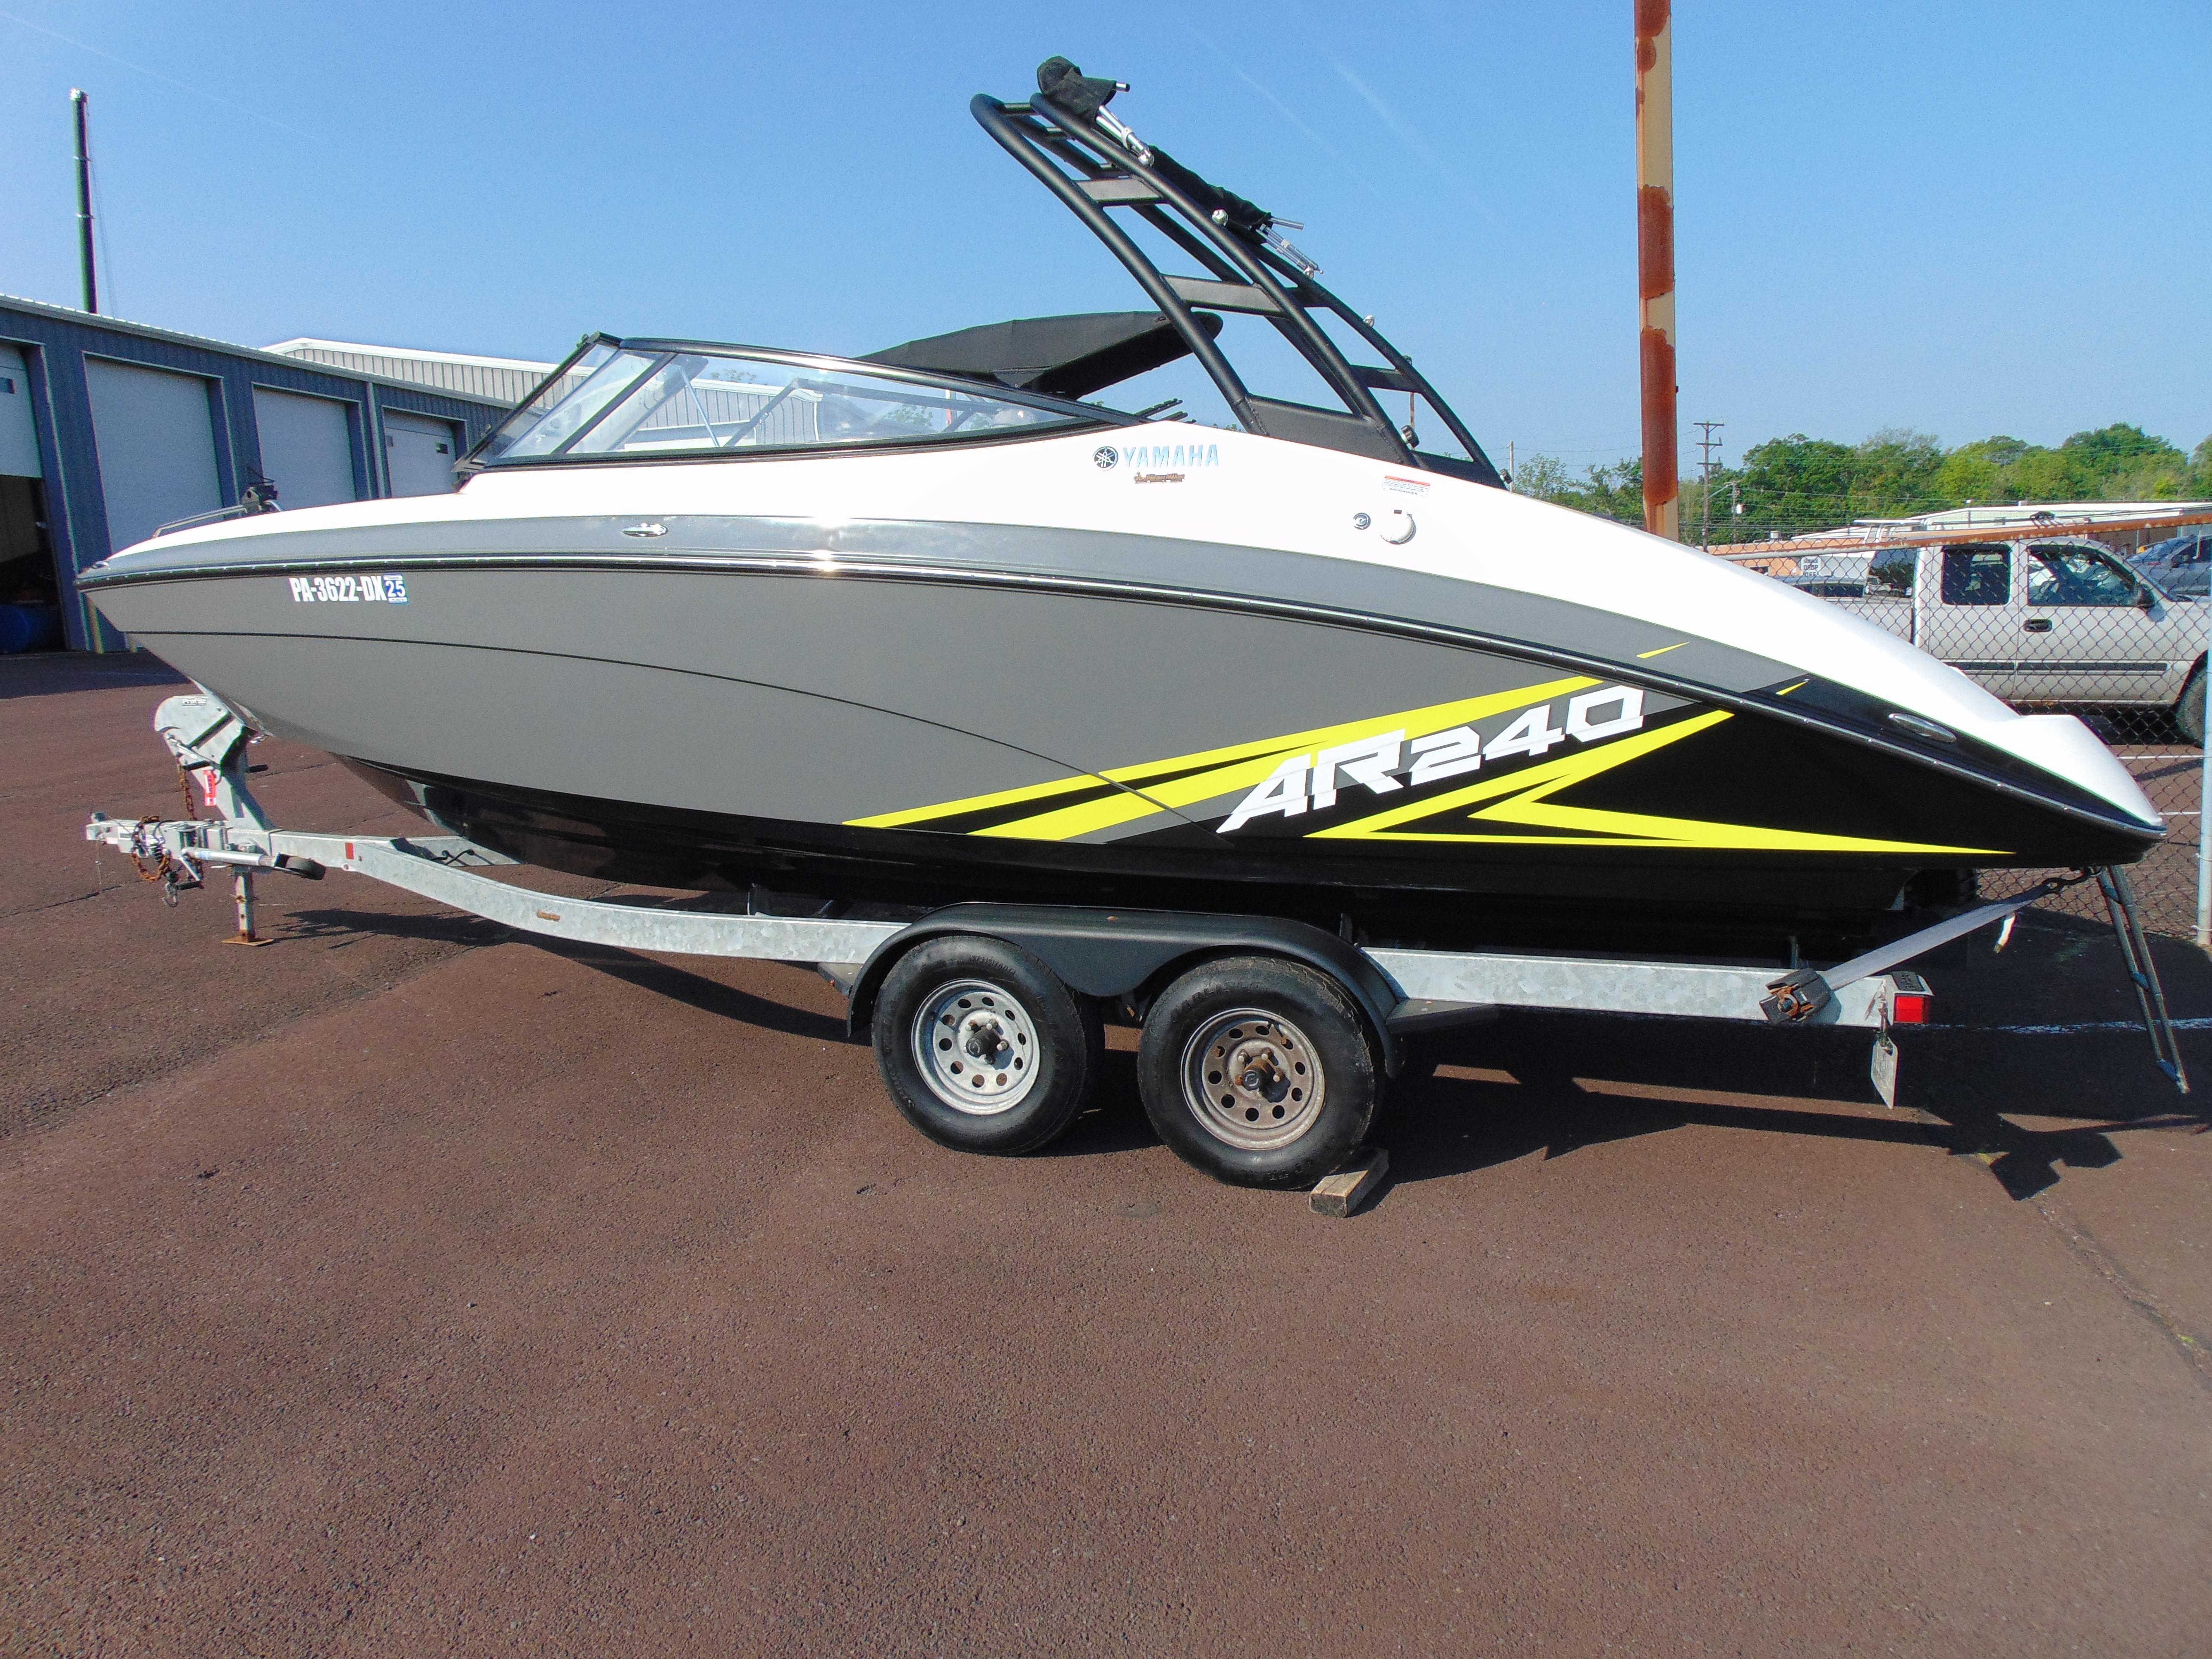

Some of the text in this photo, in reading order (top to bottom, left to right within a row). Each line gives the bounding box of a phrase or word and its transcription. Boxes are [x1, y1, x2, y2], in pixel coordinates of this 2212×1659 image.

[1123, 444, 1218, 468] YAMAHA
[289, 576, 387, 602] PA-3622-DX
[386, 580, 405, 597] 25
[1215, 684, 1644, 834] AR240
